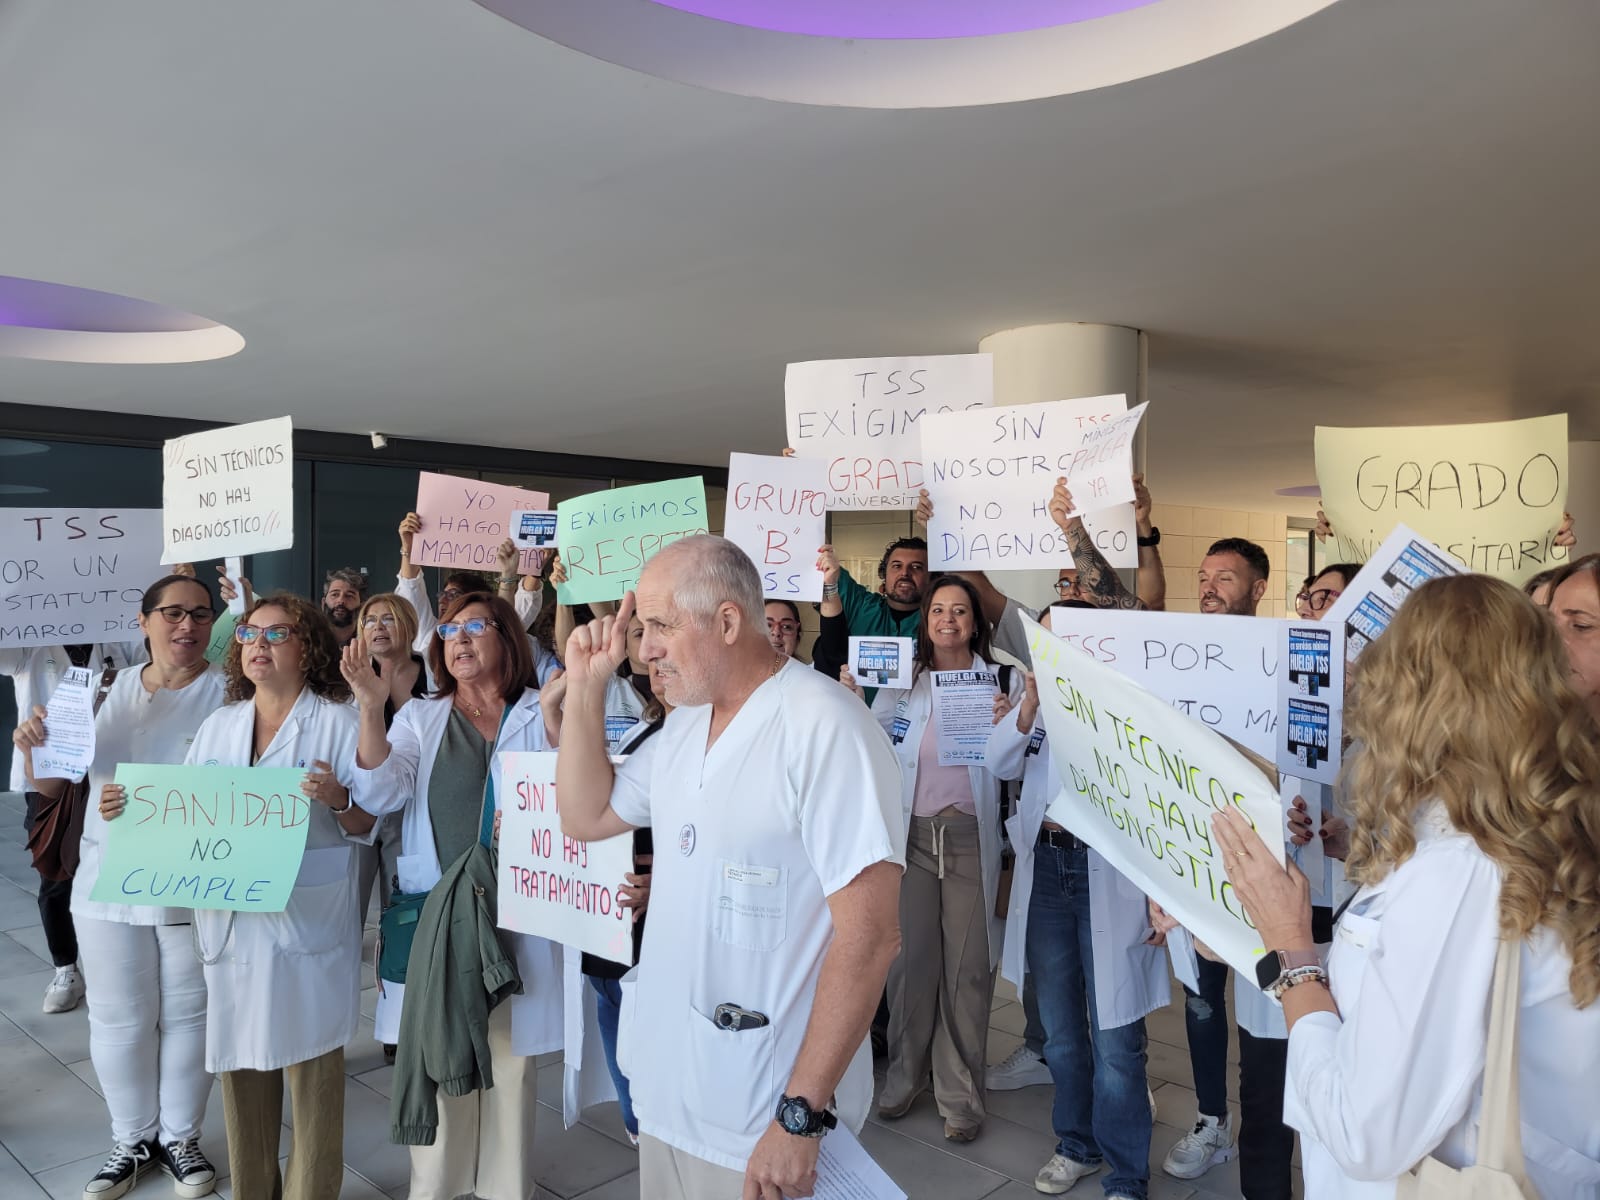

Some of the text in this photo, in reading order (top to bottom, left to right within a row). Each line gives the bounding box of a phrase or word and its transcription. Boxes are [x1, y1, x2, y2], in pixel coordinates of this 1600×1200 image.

[853, 369, 927, 398] TSS
[798, 402, 984, 439] EXIGIM
[993, 410, 1045, 443] SIN
[185, 443, 284, 480] SIN TÉCNICOS
[828, 456, 925, 492] GRAD
[933, 453, 1072, 482] NOSOTRO
[1087, 476, 1109, 498] YA
[1356, 452, 1559, 512] GRADO
[199, 486, 251, 509] NO HAY
[464, 488, 496, 511] YO
[734, 481, 827, 517] GRUPO
[826, 492, 921, 508] UNIVERSIT
[960, 501, 1002, 521] NO
[439, 515, 501, 536] HAGO
[571, 496, 698, 531] EXIGIMOS
[23, 515, 125, 542] TSS
[172, 514, 261, 544] DIAGNÓSTICO
[543, 526, 555, 535] TSS
[2, 553, 119, 584] OR UN
[764, 571, 801, 593] SS
[4, 588, 145, 611] STATUTO
[0, 613, 140, 641] MARCO DIG
[858, 657, 898, 671] HUELGA TSS
[1143, 639, 1234, 672] POR
[1289, 653, 1329, 674] HUELGA TSS
[938, 671, 977, 682] HUELGA
[1288, 723, 1327, 748] HUELGA TSS
[1055, 676, 1099, 733] SIN
[1103, 708, 1257, 832] TÉCNICOS
[134, 781, 311, 829] SANIDAD
[516, 774, 545, 814] SIN
[1093, 747, 1214, 857] NO HAY
[190, 837, 232, 861] NO
[531, 828, 552, 859] NO
[121, 868, 271, 902] CUMPLE
[509, 865, 625, 921] TRATAMIENTOS
